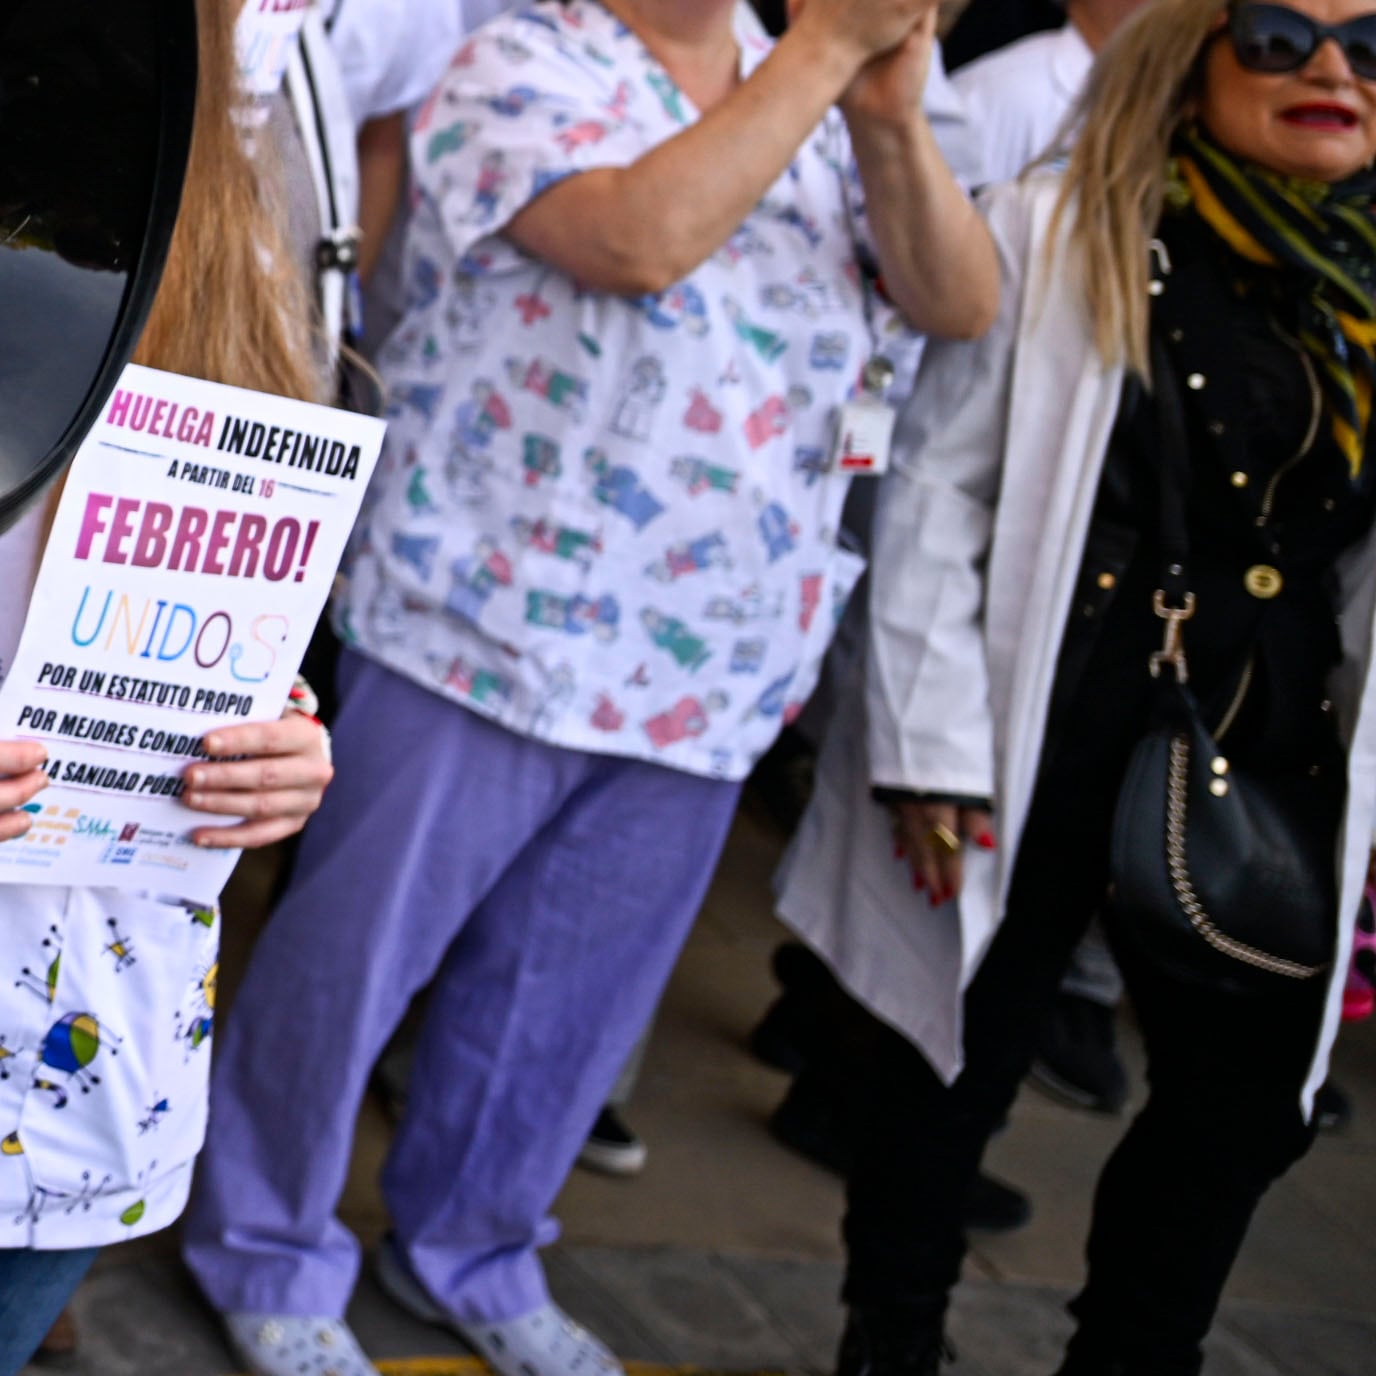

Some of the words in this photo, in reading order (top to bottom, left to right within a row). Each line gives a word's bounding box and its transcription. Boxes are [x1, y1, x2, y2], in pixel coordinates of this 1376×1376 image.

[105, 388, 216, 448] HUELGA
[216, 415, 362, 481] INDEFINIDA
[167, 459, 180, 480] A
[181, 461, 227, 489] PARTIR
[229, 474, 256, 496] DEL
[258, 477, 276, 500] 16
[73, 491, 321, 584] FEBRERO!
[70, 585, 290, 683] UNIDOS
[37, 662, 77, 692] POR
[78, 668, 105, 693] UN
[106, 674, 190, 709] ESTATUTO
[192, 686, 254, 717] PROPIO
[17, 705, 57, 731] POR
[58, 712, 138, 747] MEJORES
[138, 728, 249, 762] CONDIC
[62, 761, 138, 792] SANIDAD
[139, 773, 188, 798] PÚBL
